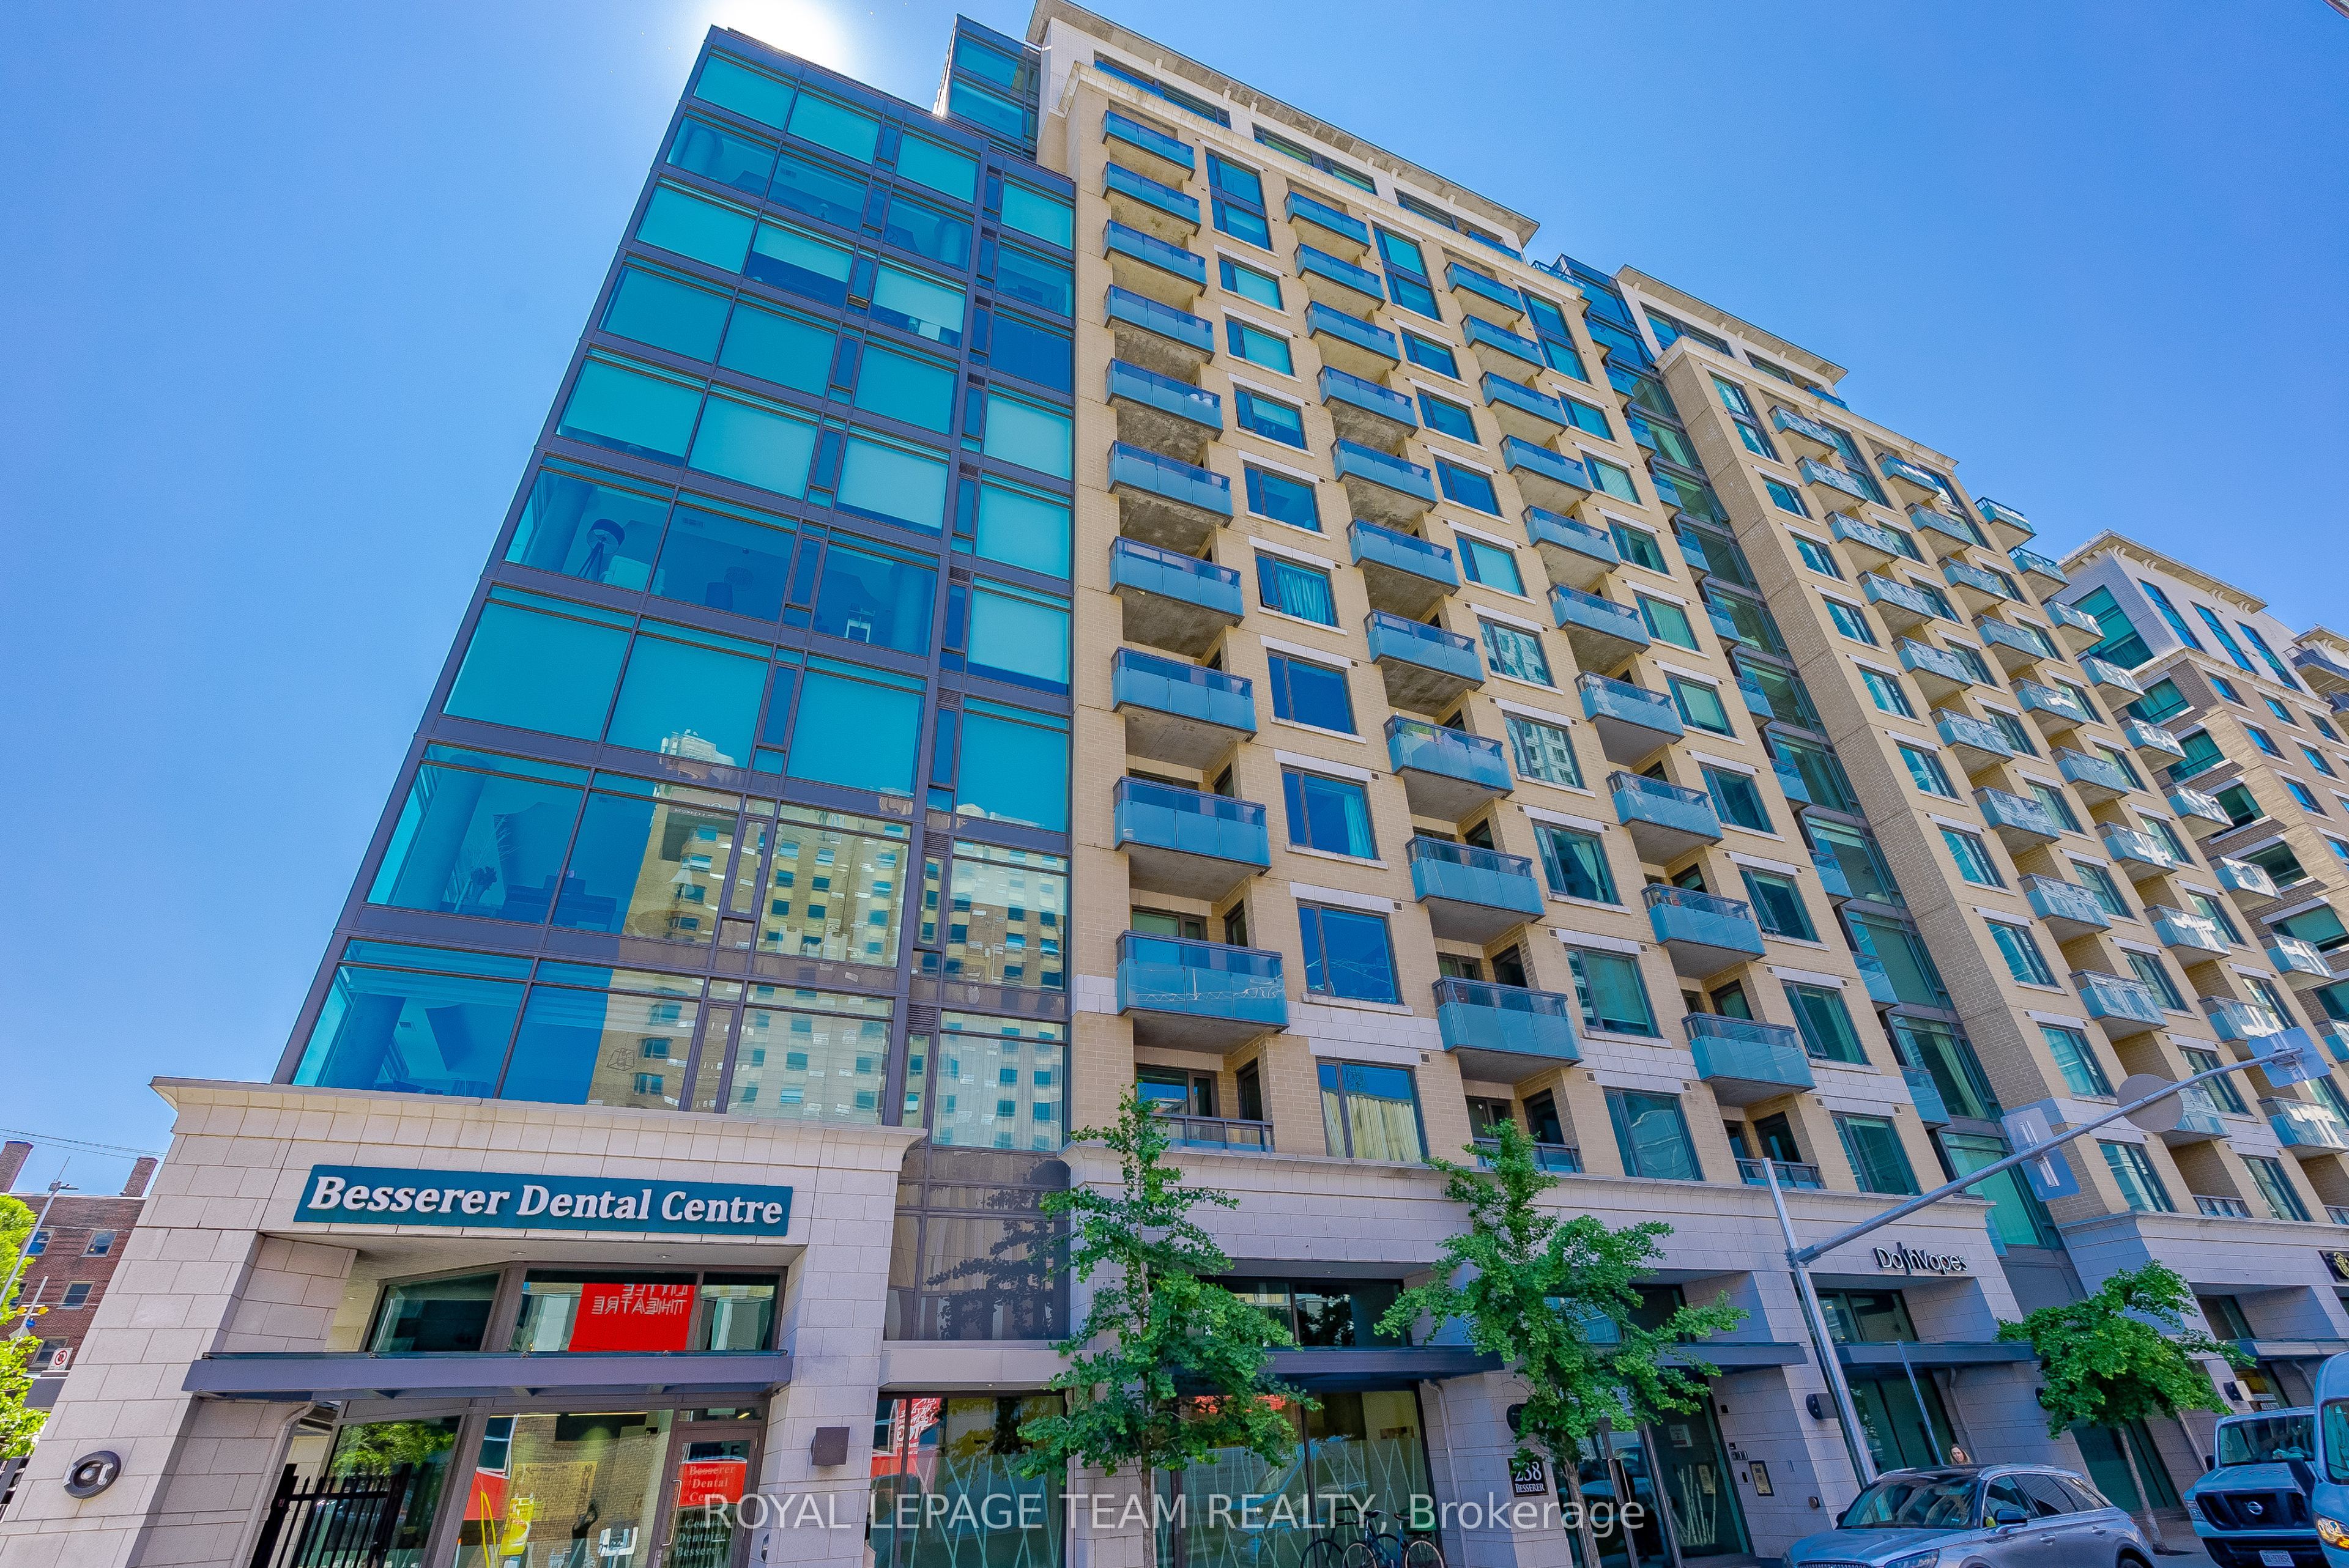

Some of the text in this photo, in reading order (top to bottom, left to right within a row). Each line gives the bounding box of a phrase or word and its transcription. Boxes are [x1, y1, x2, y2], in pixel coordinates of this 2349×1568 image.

[307, 1176, 782, 1224] Besserer Dental Centre
[689, 1466, 736, 1476] Besserer
[693, 1478, 729, 1488] Dental
[1515, 1483, 1545, 1492] BESSERER
[678, 1533, 725, 1542] Dentaire
[676, 1547, 723, 1556] Besserer
